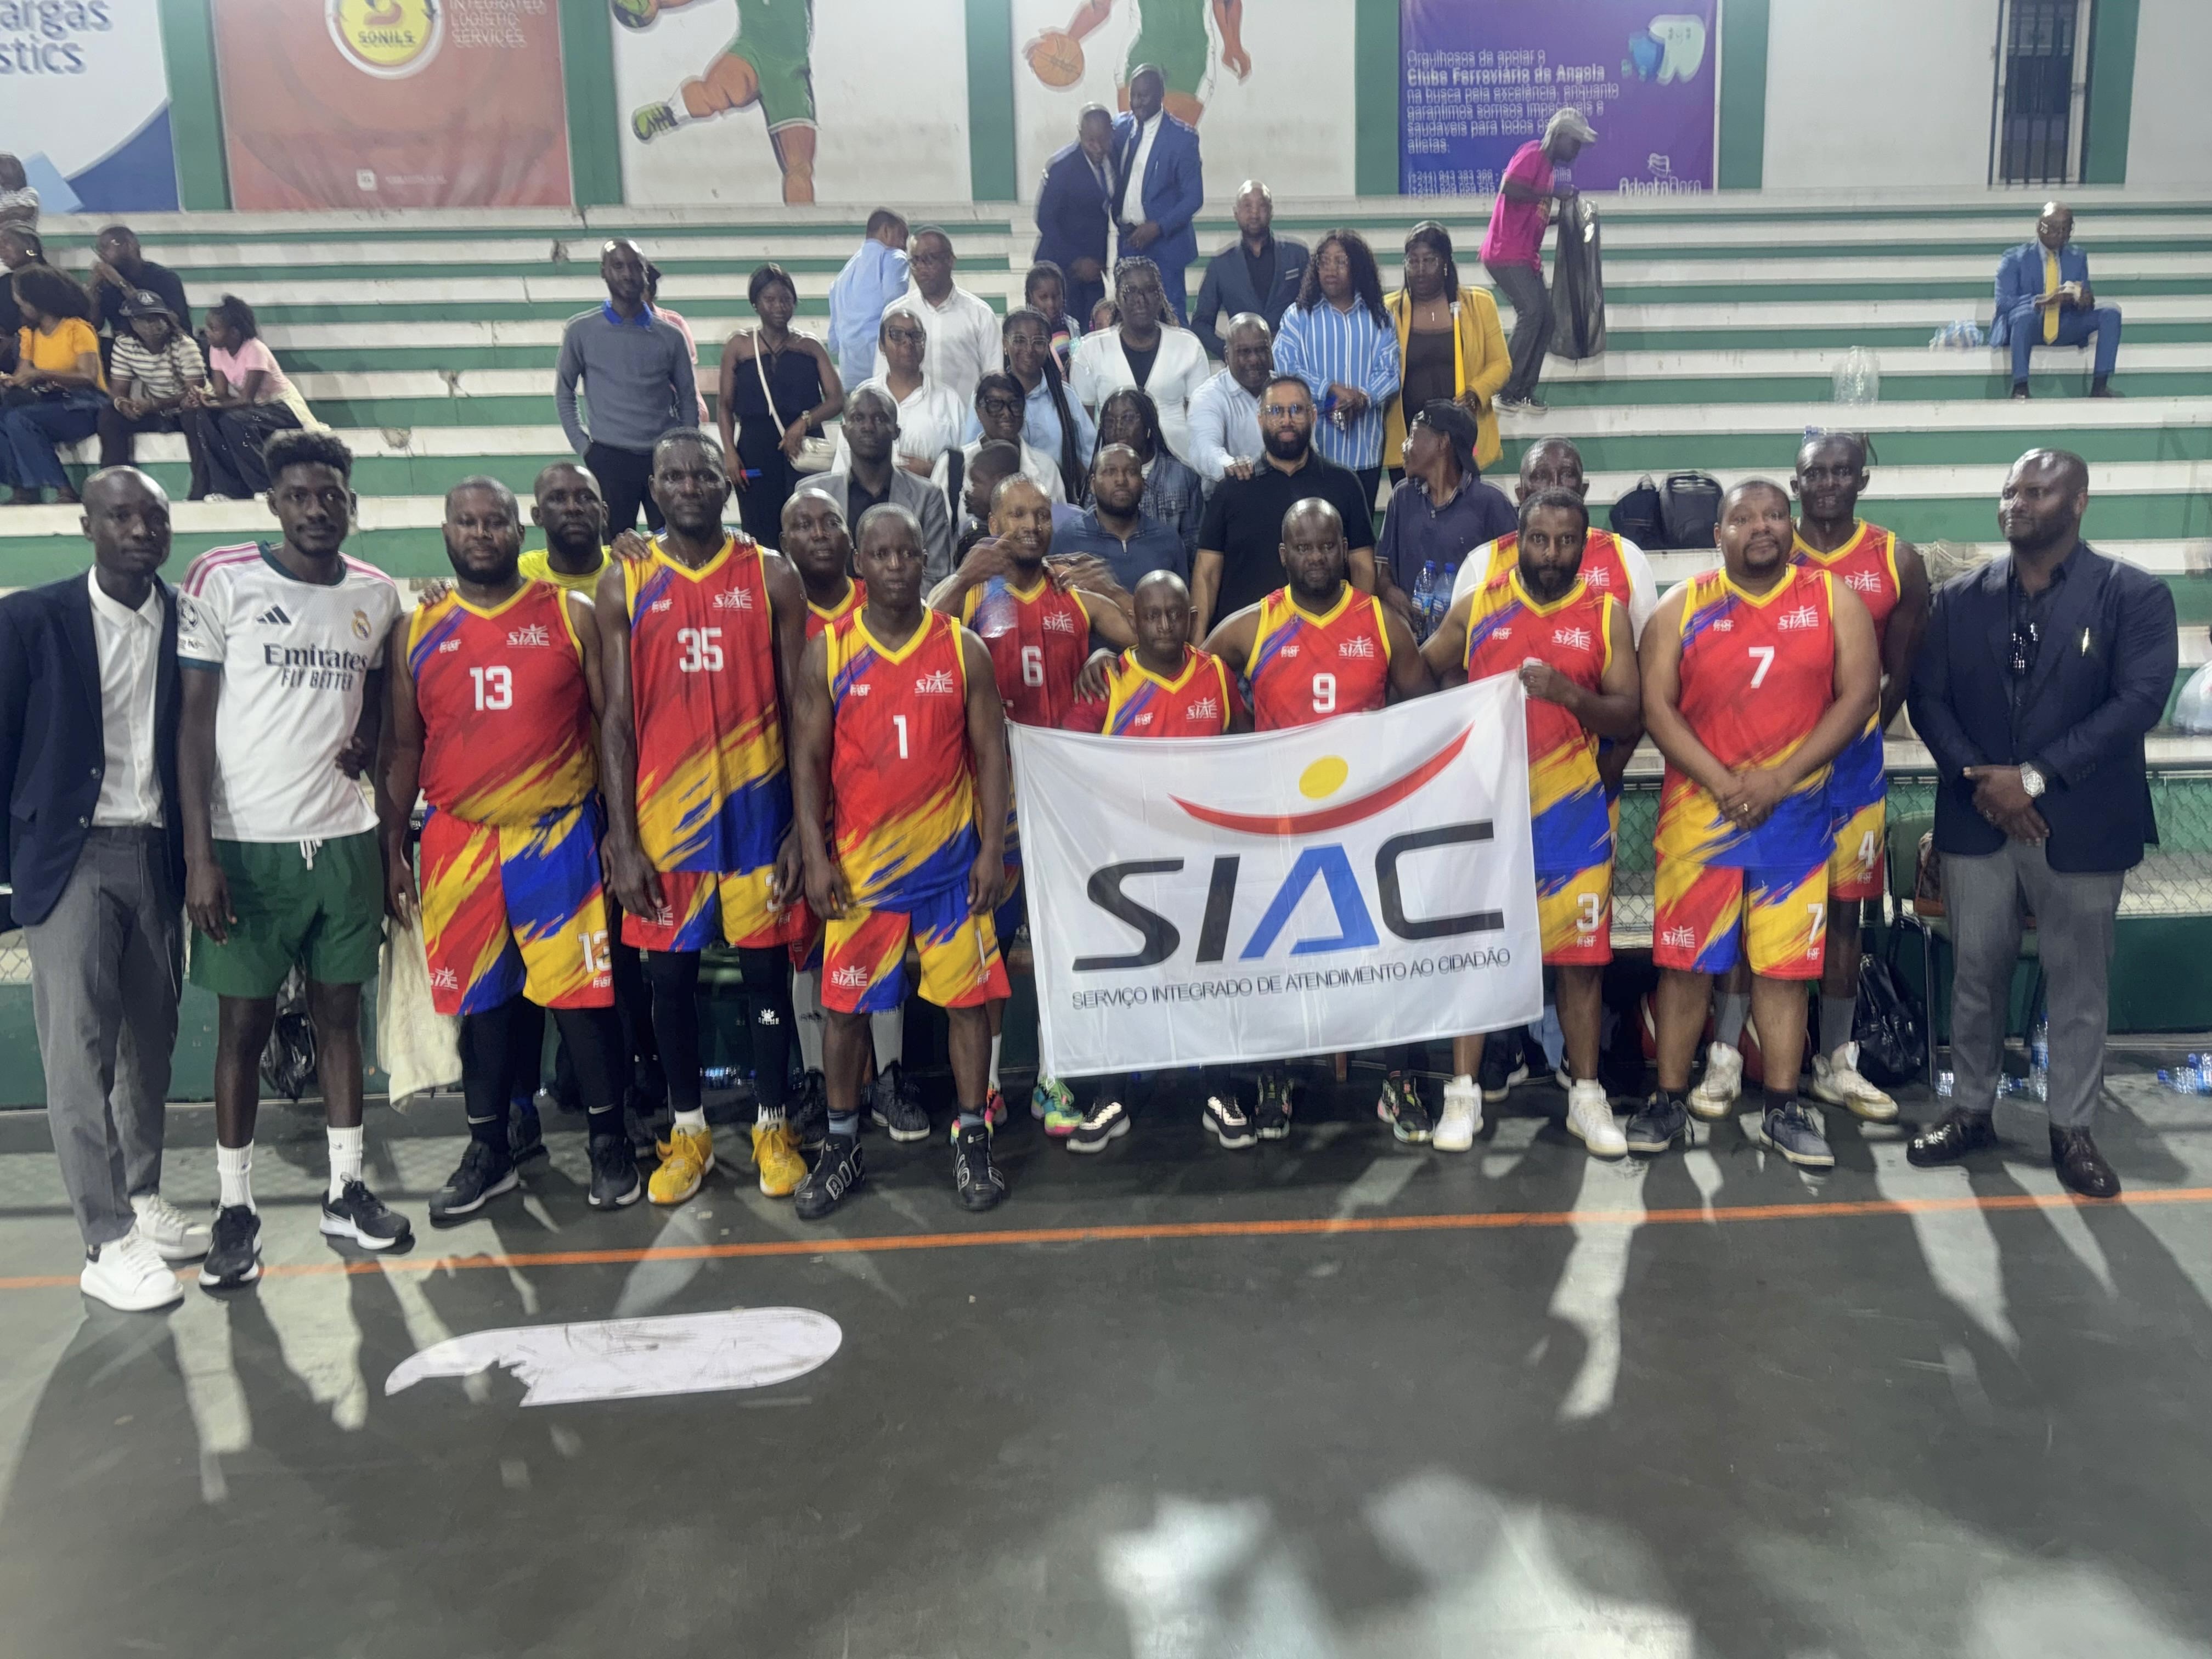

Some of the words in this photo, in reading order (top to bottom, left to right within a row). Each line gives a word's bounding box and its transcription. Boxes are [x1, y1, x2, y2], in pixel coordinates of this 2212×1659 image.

[358, 30, 417, 48] SONILS
[1407, 49, 1476, 69] Orgulhosos
[1478, 48, 1494, 67] de
[1497, 47, 1534, 69] apoiar
[1537, 49, 1545, 65] o
[1407, 67, 1448, 86] Clube
[1534, 64, 1552, 83] de
[1556, 63, 1605, 84] Angola
[1407, 89, 1422, 104] na
[1425, 86, 1461, 104] busca
[1464, 85, 1490, 106] pela
[1563, 82, 1619, 101] enquanto
[1407, 103, 1474, 122] garantimos
[1476, 102, 1523, 120] sorrisos
[1596, 100, 1604, 116] e
[1470, 120, 1498, 139] para
[1501, 116, 1534, 136] todos
[263, 642, 368, 673] Emirates
[506, 631, 550, 646] SIAC
[677, 627, 724, 672] 35
[281, 667, 305, 688] FLY
[310, 669, 353, 692] BETTER
[915, 679, 953, 693] SIAC
[1022, 646, 1043, 686] 6
[1748, 646, 1775, 689] 7
[470, 665, 513, 711] 13
[1312, 673, 1336, 713] 9
[893, 715, 909, 759] 1
[1858, 830, 1874, 869] 4
[1072, 818, 1505, 972] SIAC
[1576, 892, 1599, 933] 3
[1807, 902, 1824, 944] 7
[578, 930, 612, 973] 13
[974, 927, 986, 967] 1
[1072, 986, 1148, 1010] SERVIÇO
[1152, 978, 1252, 1003] INTEGRADO
[1257, 975, 1282, 995] DE
[1285, 961, 1407, 992] ATENDIMENTO
[1410, 958, 1434, 979] AO
[1438, 947, 1511, 974] CIDADÃO
